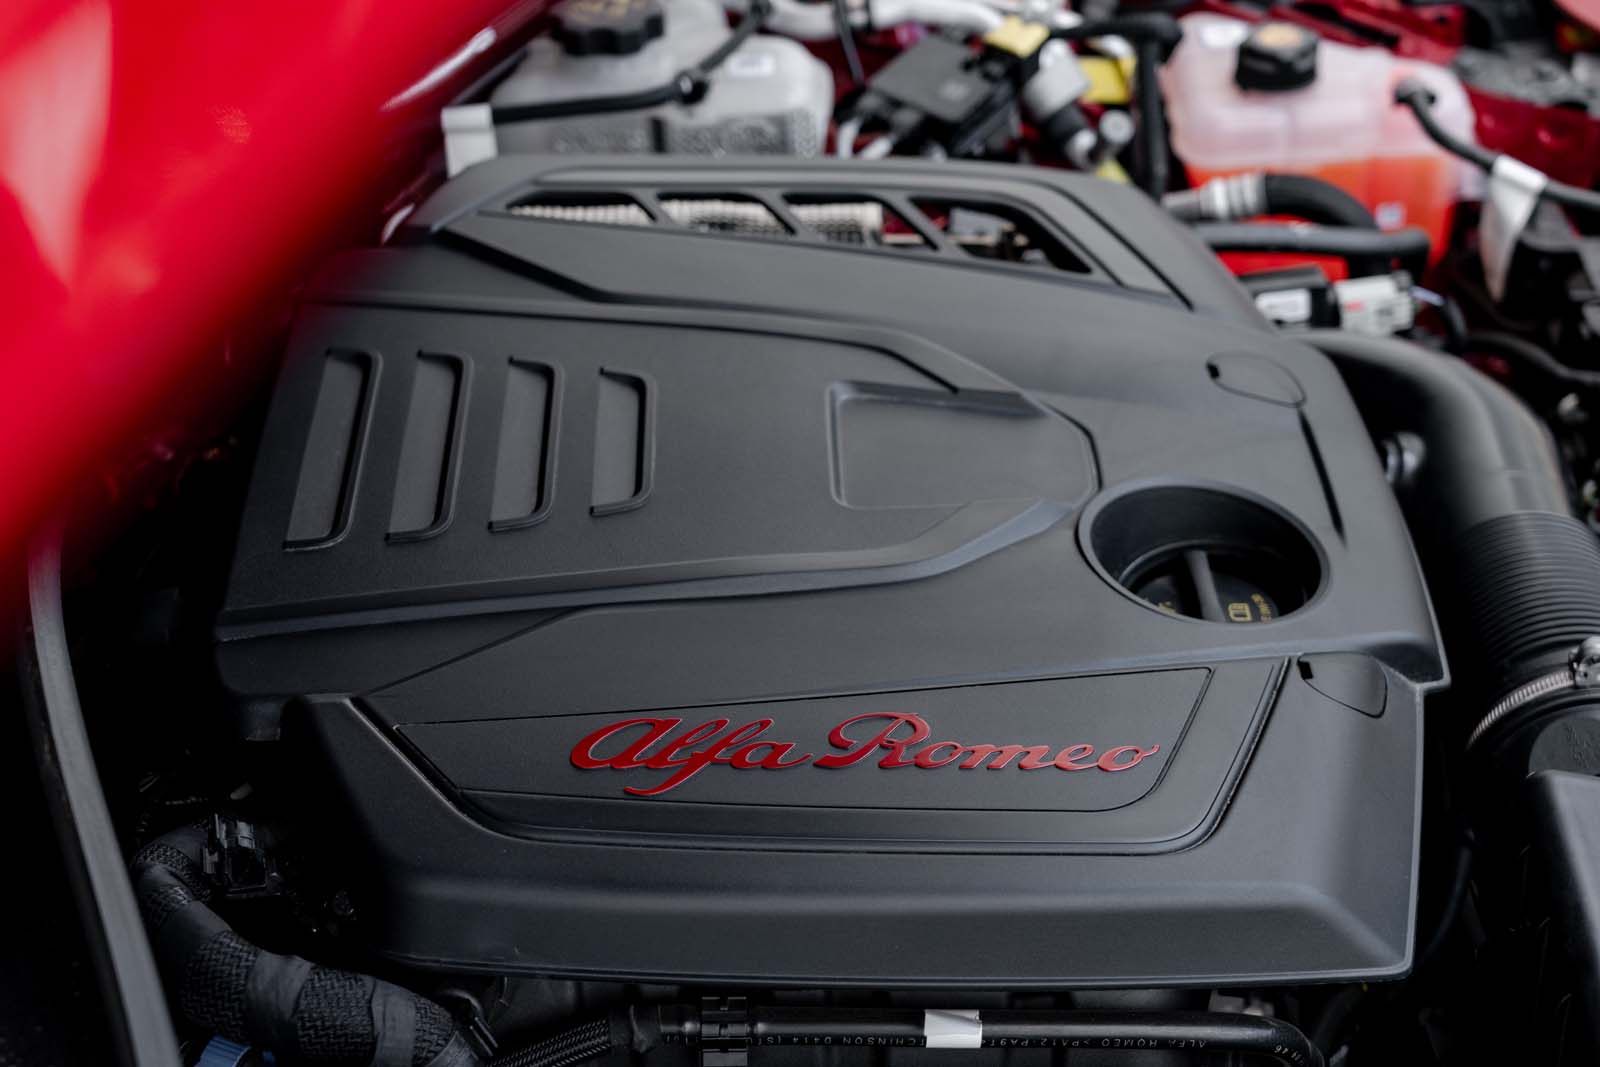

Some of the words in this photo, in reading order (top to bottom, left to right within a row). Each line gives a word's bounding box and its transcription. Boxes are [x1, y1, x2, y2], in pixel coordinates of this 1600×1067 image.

[570, 717, 813, 796] Alfa
[813, 711, 1160, 772] Romeo
[842, 1036, 925, 1047] TCHINSON
[1101, 1038, 1158, 1048] ROMEO
[1167, 1039, 1207, 1048] ALFA
